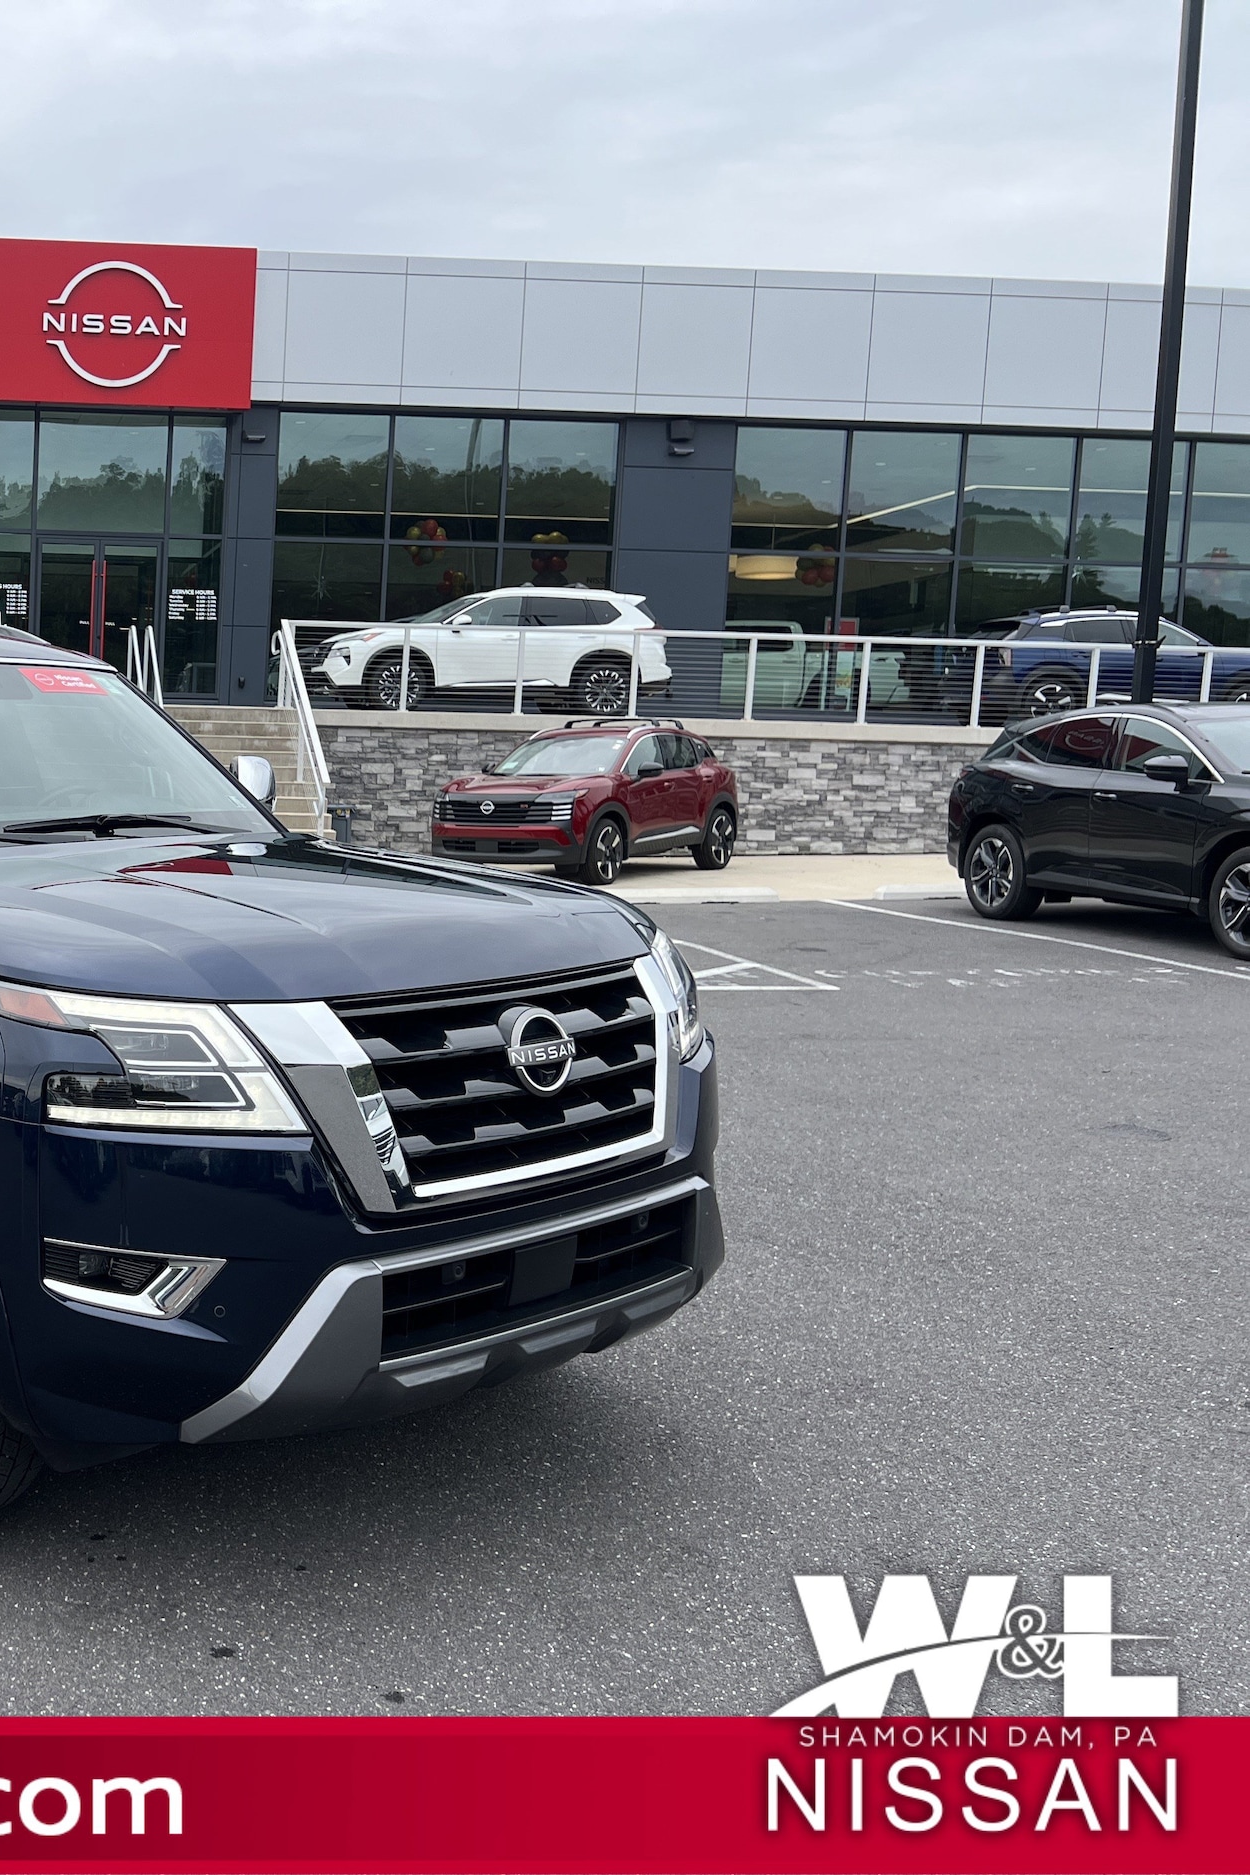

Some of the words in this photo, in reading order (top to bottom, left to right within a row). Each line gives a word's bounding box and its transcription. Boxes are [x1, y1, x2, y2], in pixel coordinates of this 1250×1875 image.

[42, 312, 187, 337] NISSAN
[54, 674, 83, 682] Nissan
[61, 681, 97, 689] Certified
[511, 1041, 576, 1065] NISSAN
